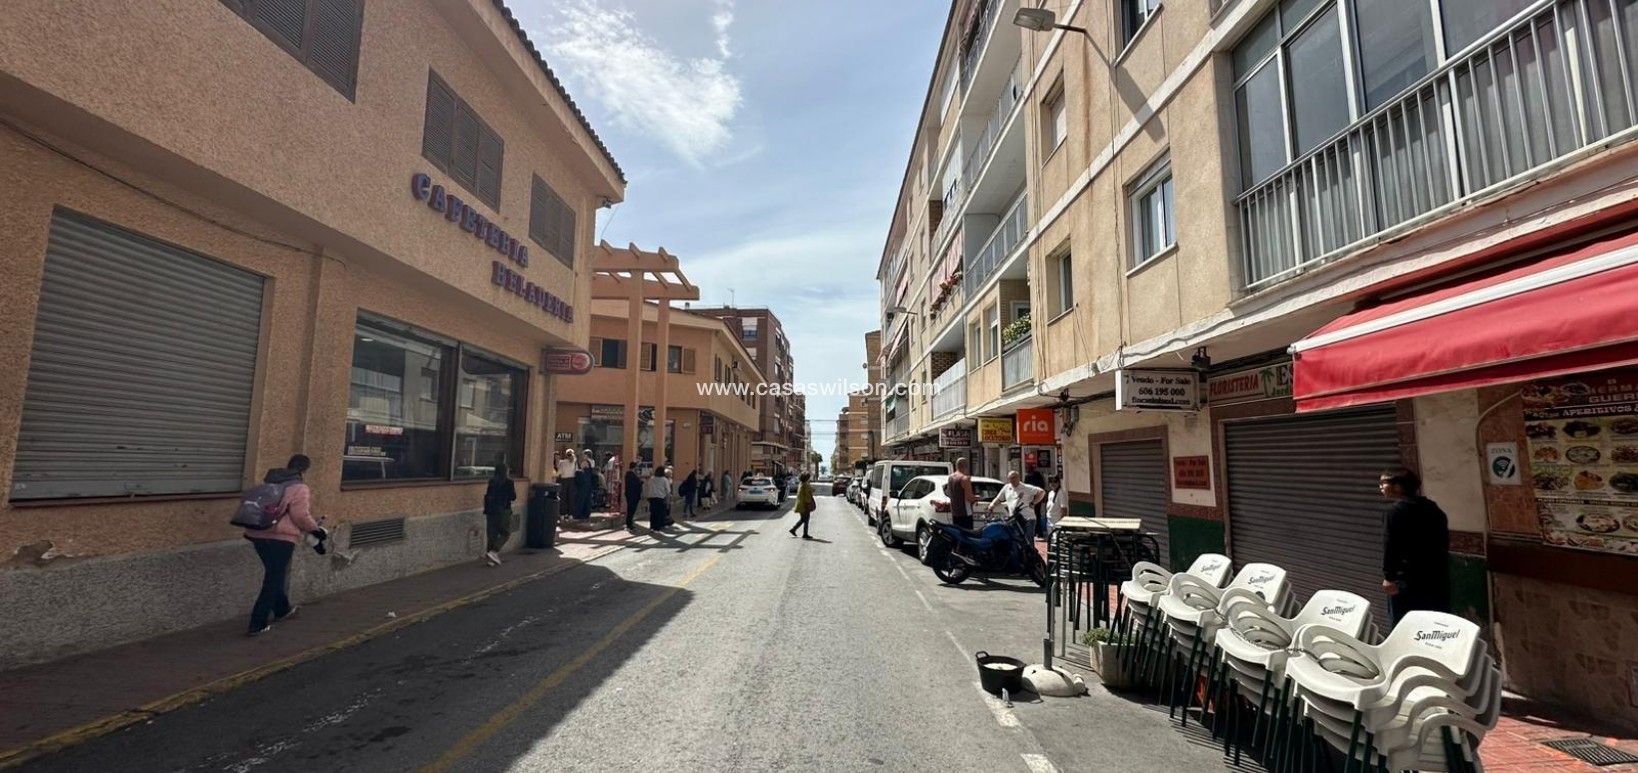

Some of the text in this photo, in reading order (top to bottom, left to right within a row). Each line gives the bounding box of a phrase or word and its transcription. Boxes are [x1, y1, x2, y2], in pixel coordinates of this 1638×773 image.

[1131, 376, 1154, 385] Vendo
[1160, 376, 1174, 385] For
[1175, 376, 1192, 386] Sale
[1209, 373, 1259, 397] FLORISTERIA
[1138, 387, 1186, 397] 606 195 000
[1023, 415, 1049, 432] ria
